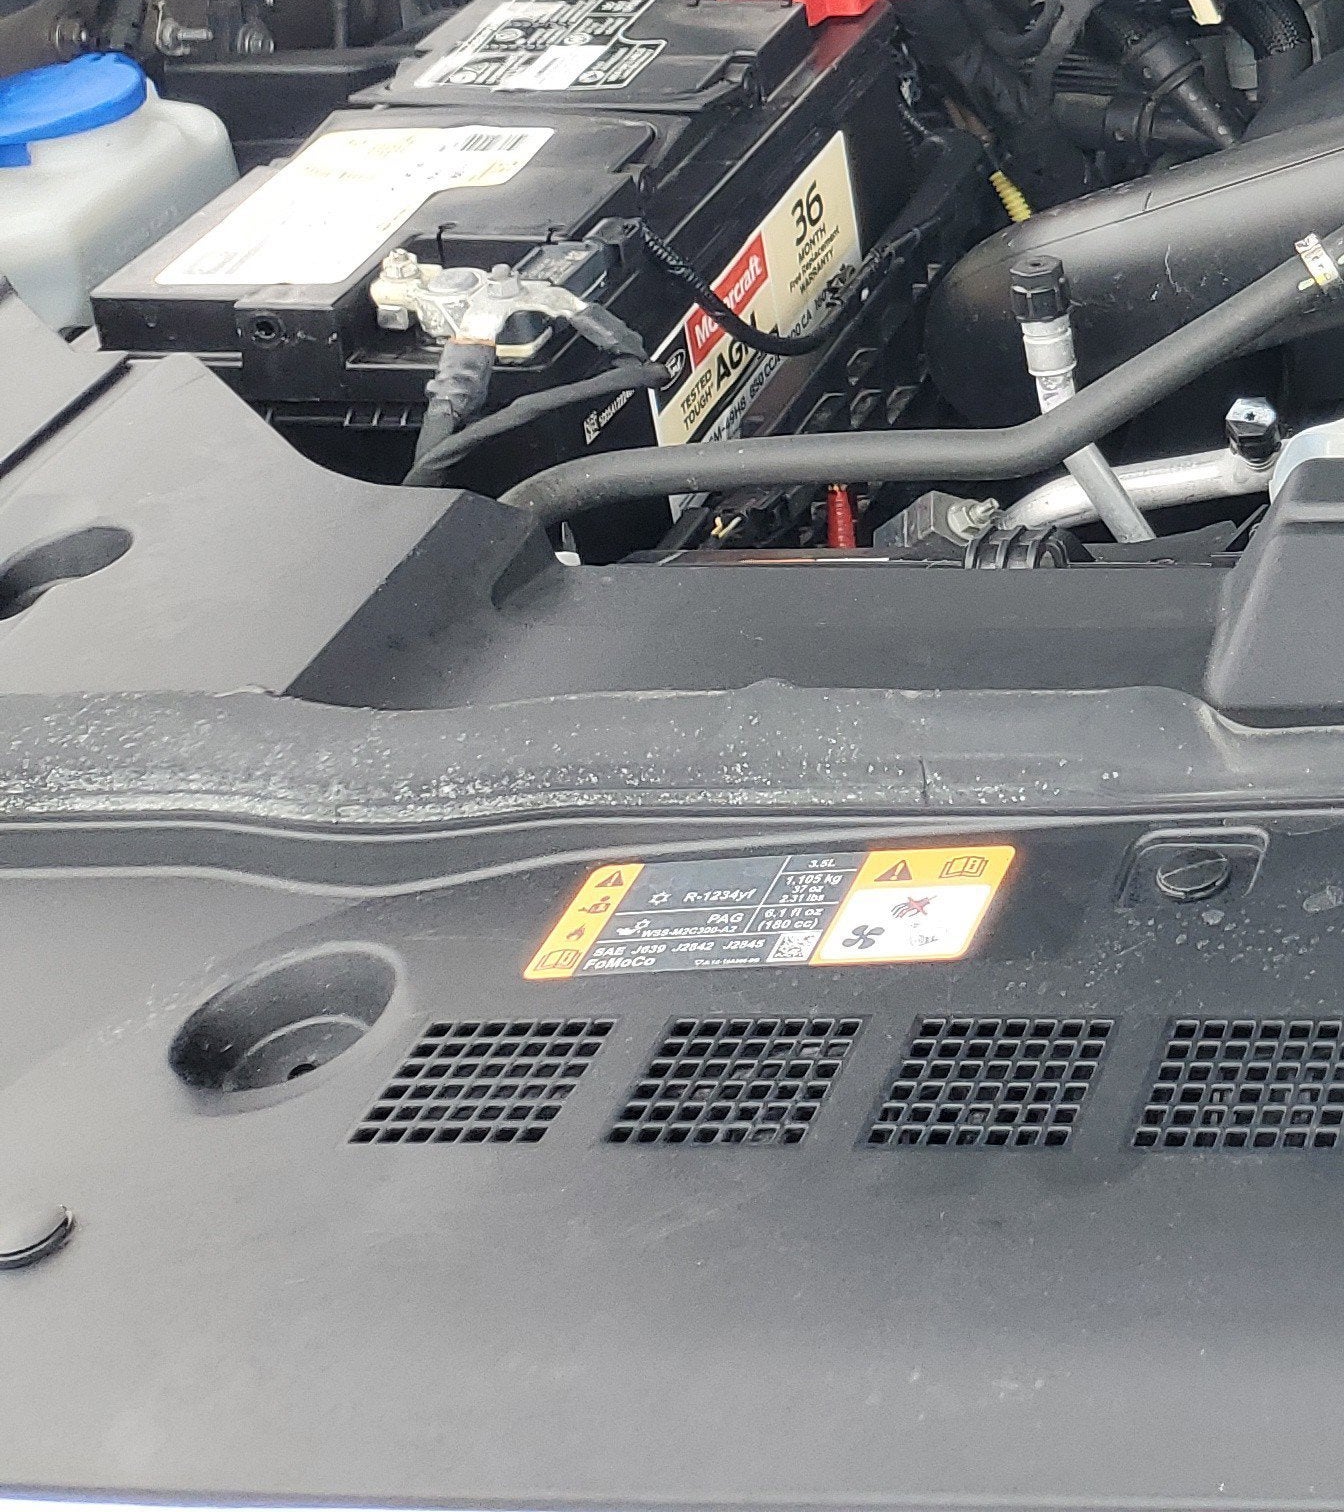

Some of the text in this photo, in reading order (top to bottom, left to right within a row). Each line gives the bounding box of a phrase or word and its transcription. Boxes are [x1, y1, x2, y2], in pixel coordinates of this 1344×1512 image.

[790, 179, 824, 247] 36
[797, 221, 826, 264] MONTH
[788, 225, 839, 292] Free Replacement
[800, 245, 833, 293] WARRANTY
[680, 368, 713, 413] TESTED
[808, 858, 836, 868] 3.5L
[823, 874, 843, 885] kg
[683, 888, 757, 903] R-1234yf
[792, 886, 807, 894] 37
[779, 894, 825, 903] 2.31 lbs
[707, 912, 745, 924] PAG
[764, 908, 824, 918] 6.1 fl oz
[757, 918, 819, 932] (180 cc)
[593, 939, 767, 957] SAE J639 J2842 J2845
[582, 956, 657, 971] FoMoCo
